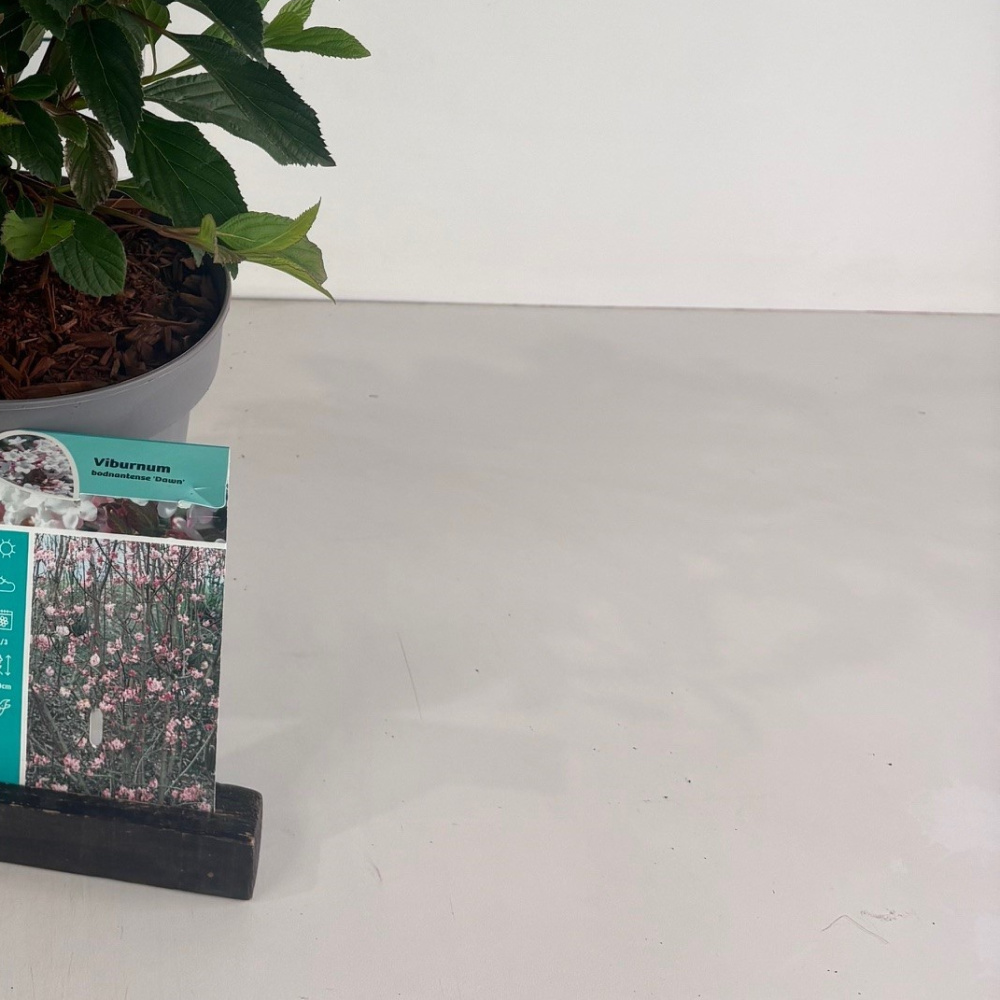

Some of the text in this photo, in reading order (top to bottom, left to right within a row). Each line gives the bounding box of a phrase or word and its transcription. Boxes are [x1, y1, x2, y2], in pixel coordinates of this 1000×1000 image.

[93, 457, 171, 474] Viburnum
[91, 469, 185, 485] bodnantense 'Dawn'
